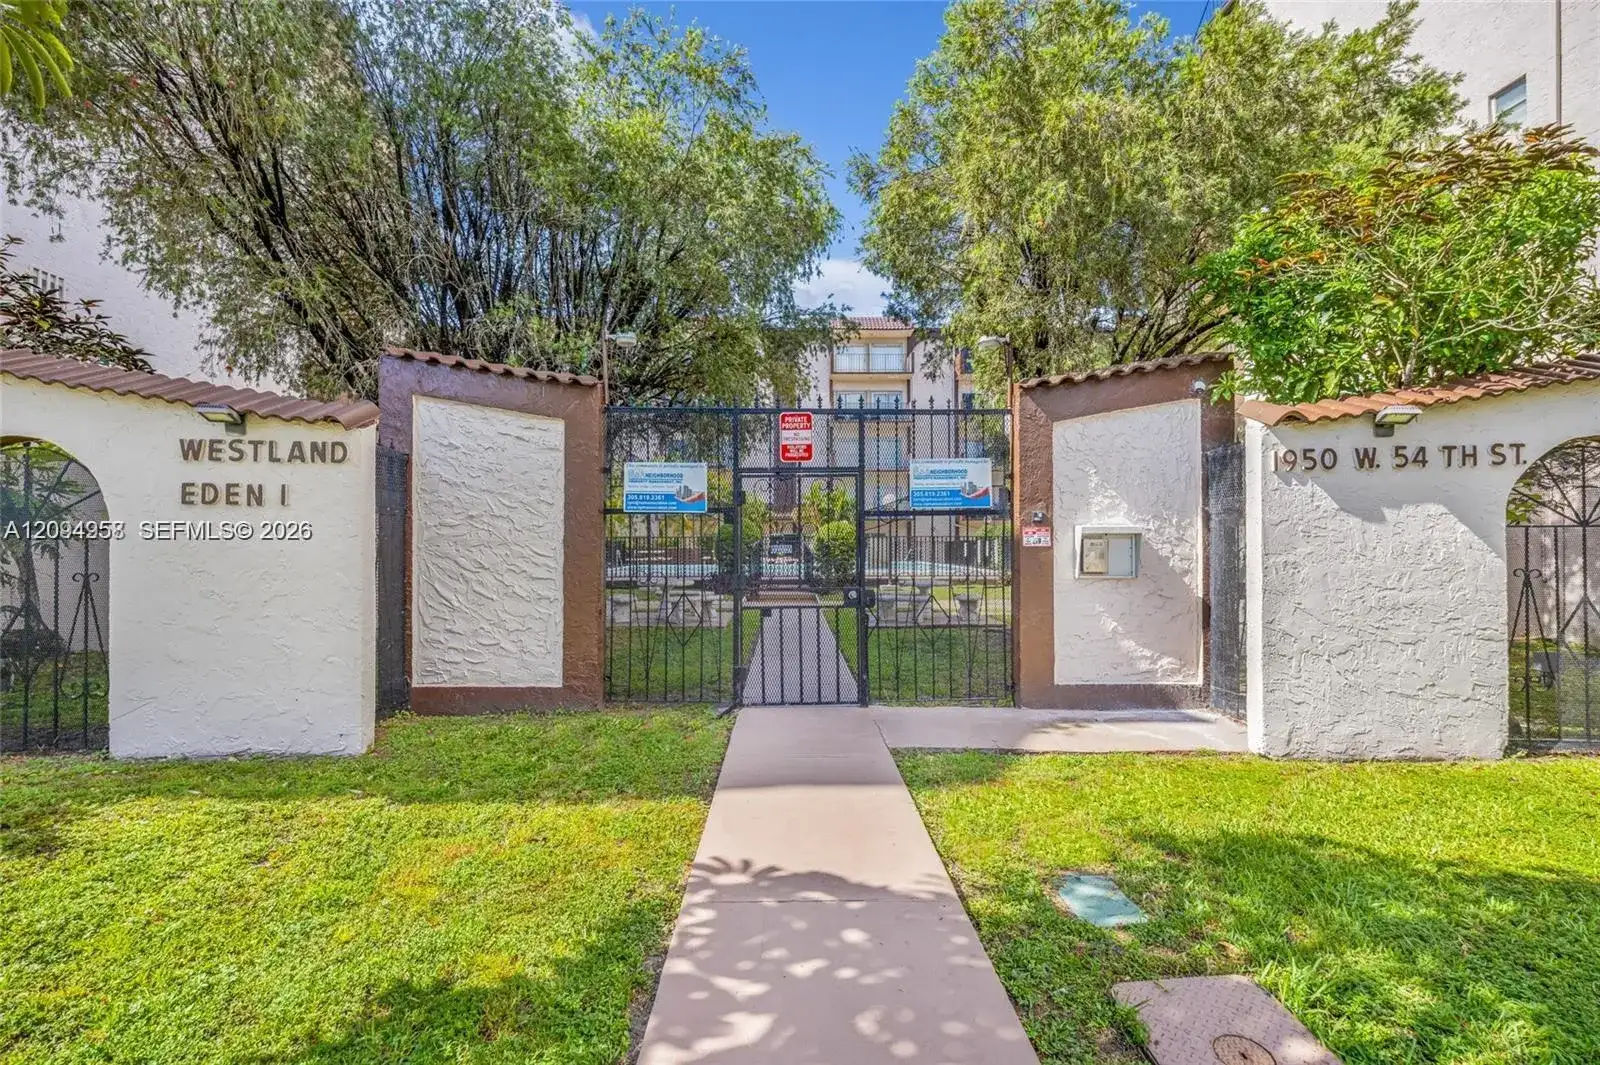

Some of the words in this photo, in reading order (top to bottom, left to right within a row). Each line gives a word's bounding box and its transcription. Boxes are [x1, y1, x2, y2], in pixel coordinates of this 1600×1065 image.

[179, 438, 348, 464] WESTLAND
[1272, 447, 1338, 471] 1950
[1354, 447, 1380, 469] W.
[1392, 445, 1428, 469] 54
[1439, 445, 1478, 468] TH
[1489, 443, 1528, 466] ST.
[180, 482, 264, 507] EDEN
[280, 483, 290, 507] I
